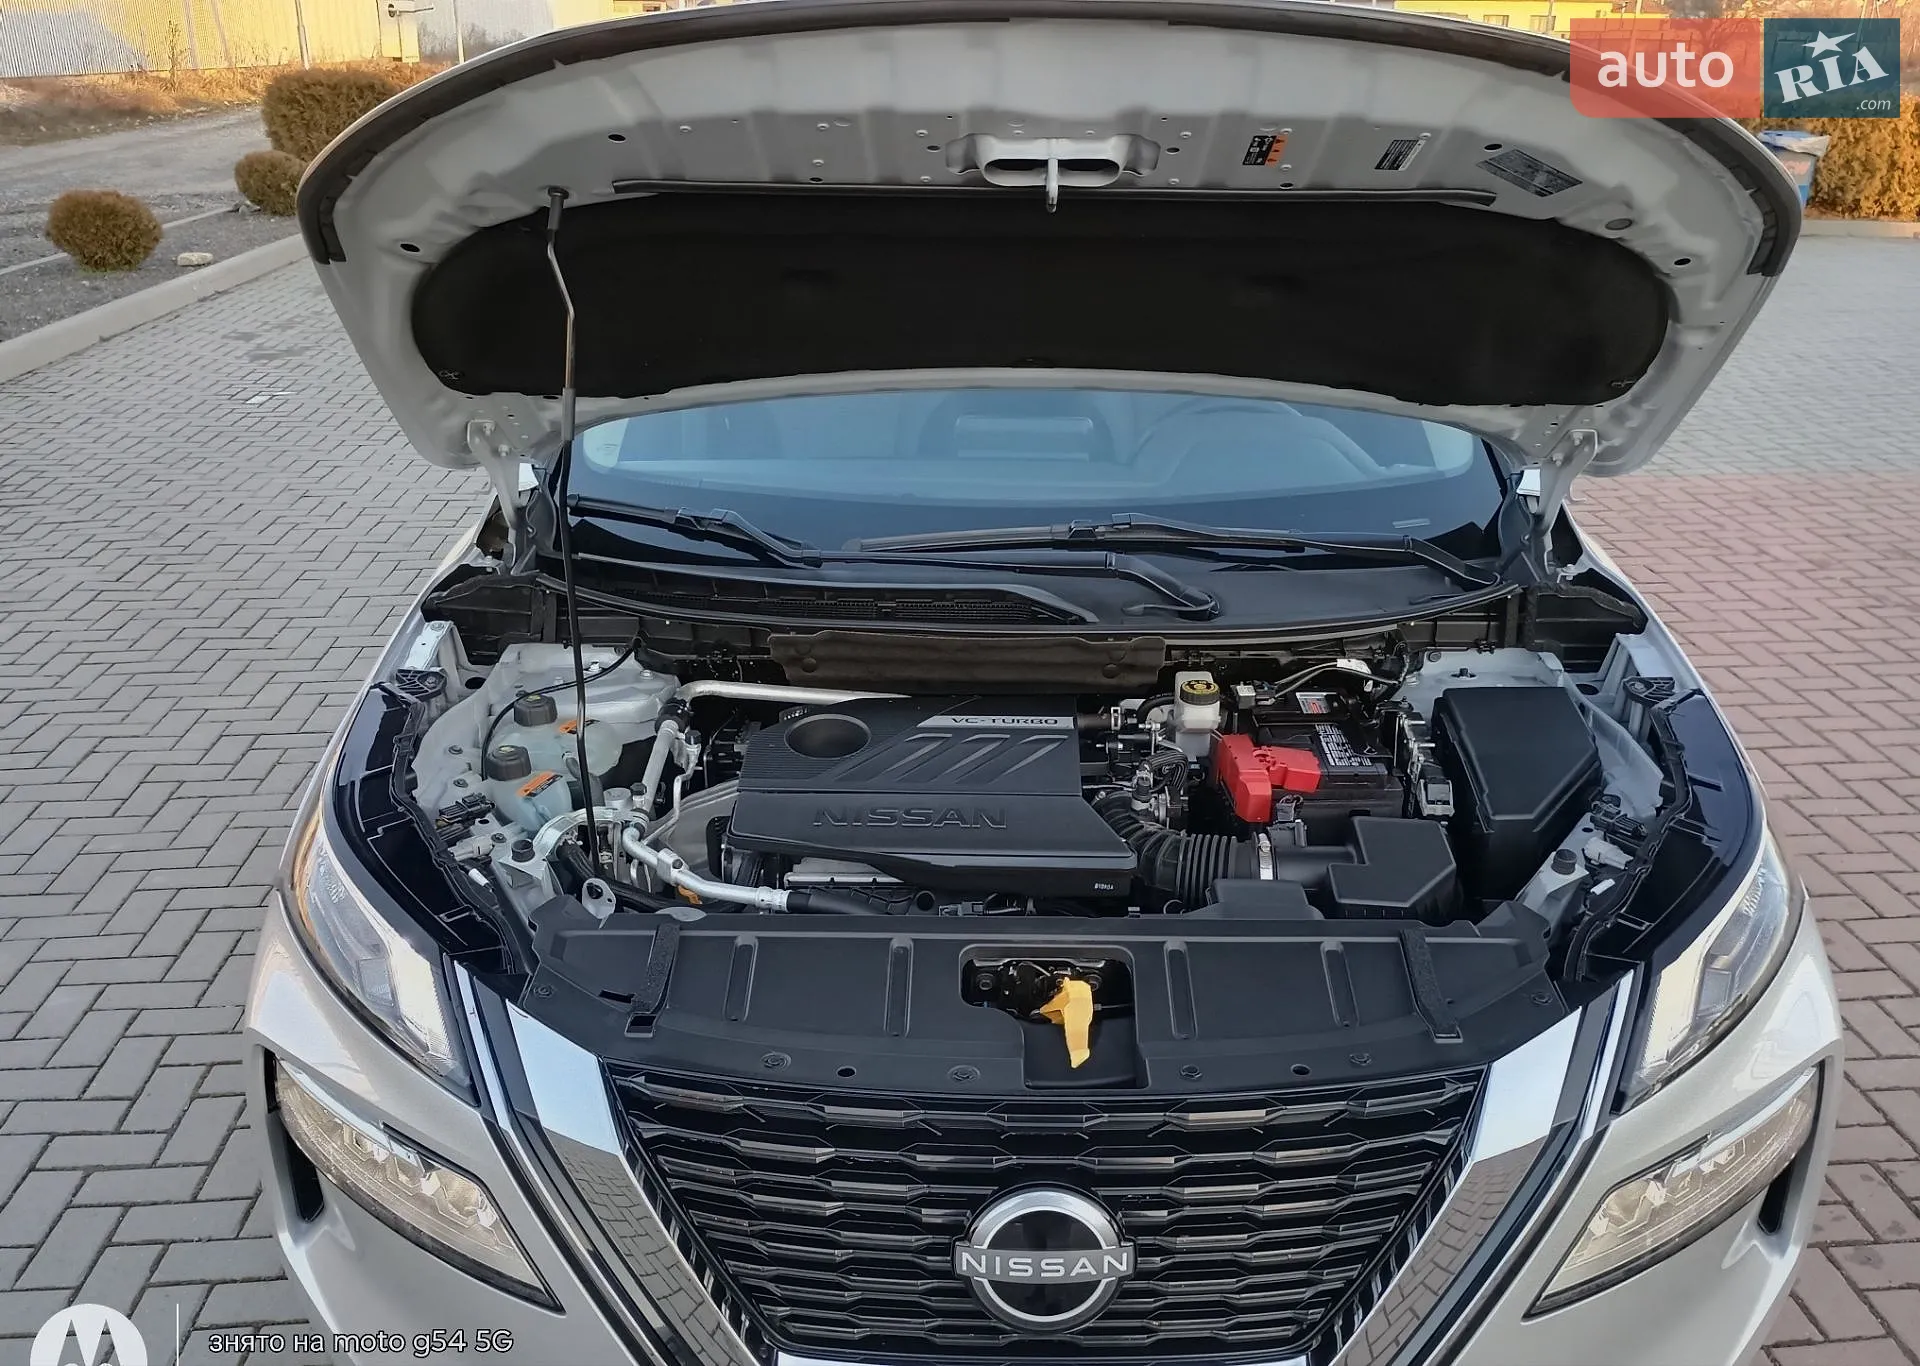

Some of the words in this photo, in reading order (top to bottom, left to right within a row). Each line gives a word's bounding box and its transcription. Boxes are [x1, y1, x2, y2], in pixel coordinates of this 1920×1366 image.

[951, 717, 1058, 725] VC-TURBO
[813, 807, 1007, 828] NISSAN
[961, 1251, 1128, 1278] NISSAN
